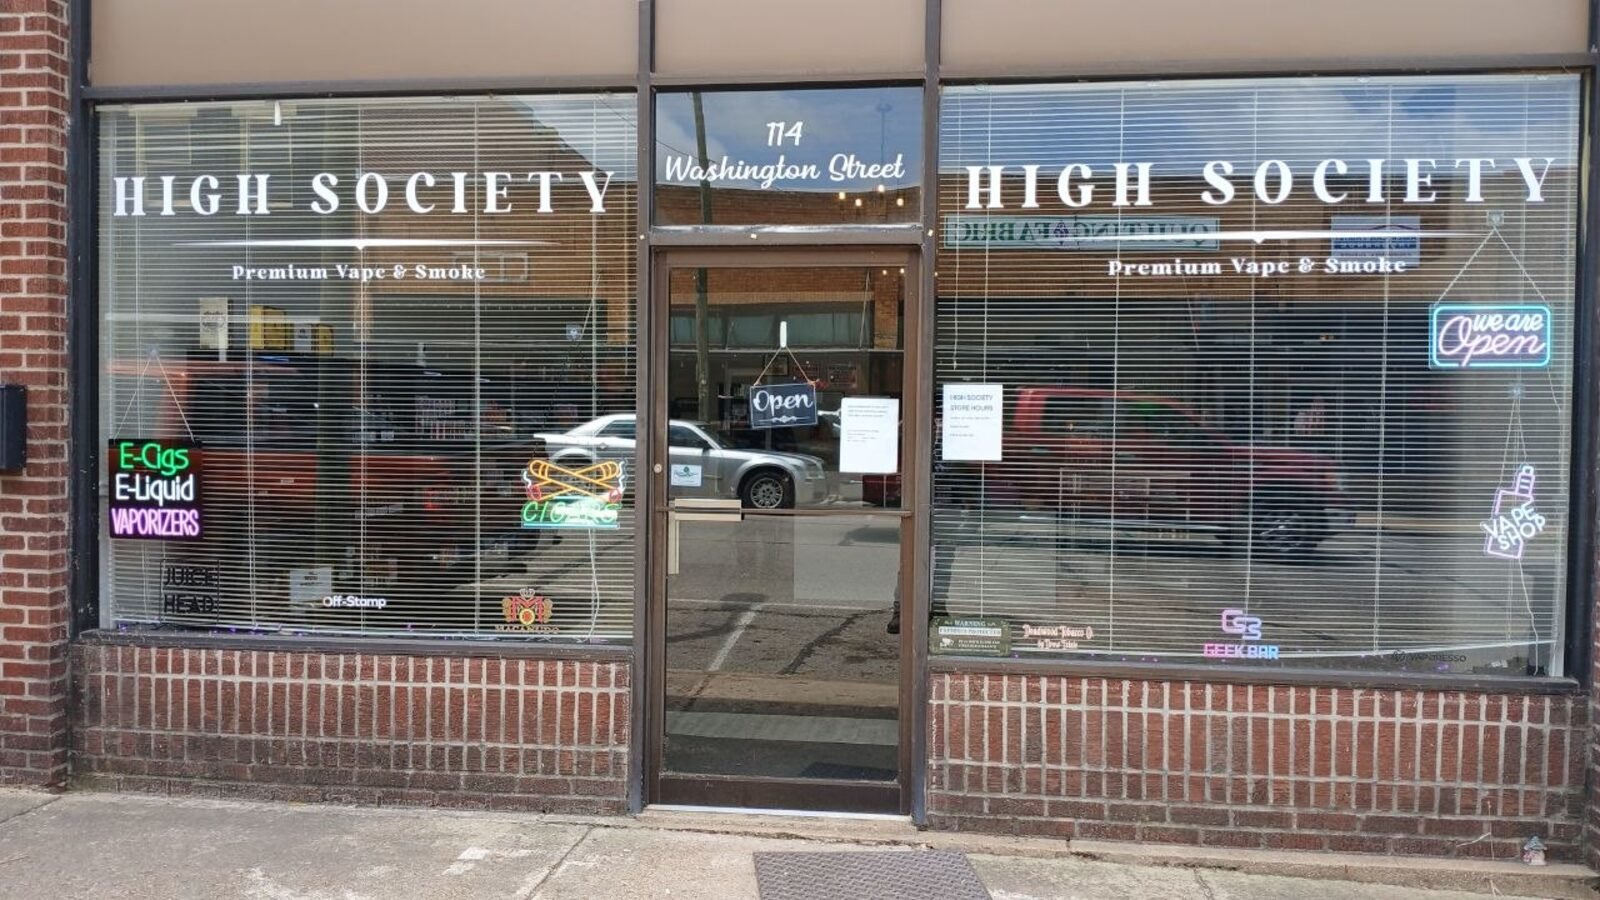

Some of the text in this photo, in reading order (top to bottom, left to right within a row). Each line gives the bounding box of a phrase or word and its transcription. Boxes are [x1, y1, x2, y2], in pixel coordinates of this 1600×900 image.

[766, 121, 804, 147] 114
[665, 152, 906, 190] Washington Street
[964, 157, 1556, 210] HIGH SOCIETY
[113, 170, 616, 217] HIGH SOCIETY
[231, 262, 487, 284] Premium Vape & Smoke
[1107, 256, 1408, 279] Premium Vape & Smoke
[1472, 313, 1544, 332] we are
[1438, 315, 1546, 367] Open
[752, 389, 814, 417] Open
[120, 441, 190, 476] E-Cigs
[115, 473, 195, 507] E-Liquid
[111, 507, 200, 537] VAPORIZERS
[523, 500, 620, 524] CIGRS
[1481, 501, 1536, 539] VAPE
[1496, 513, 1547, 551] SHOP
[164, 592, 215, 613] HEAD
[322, 595, 387, 610] Off-Stamp
[1203, 643, 1280, 660] GEEK BAR
